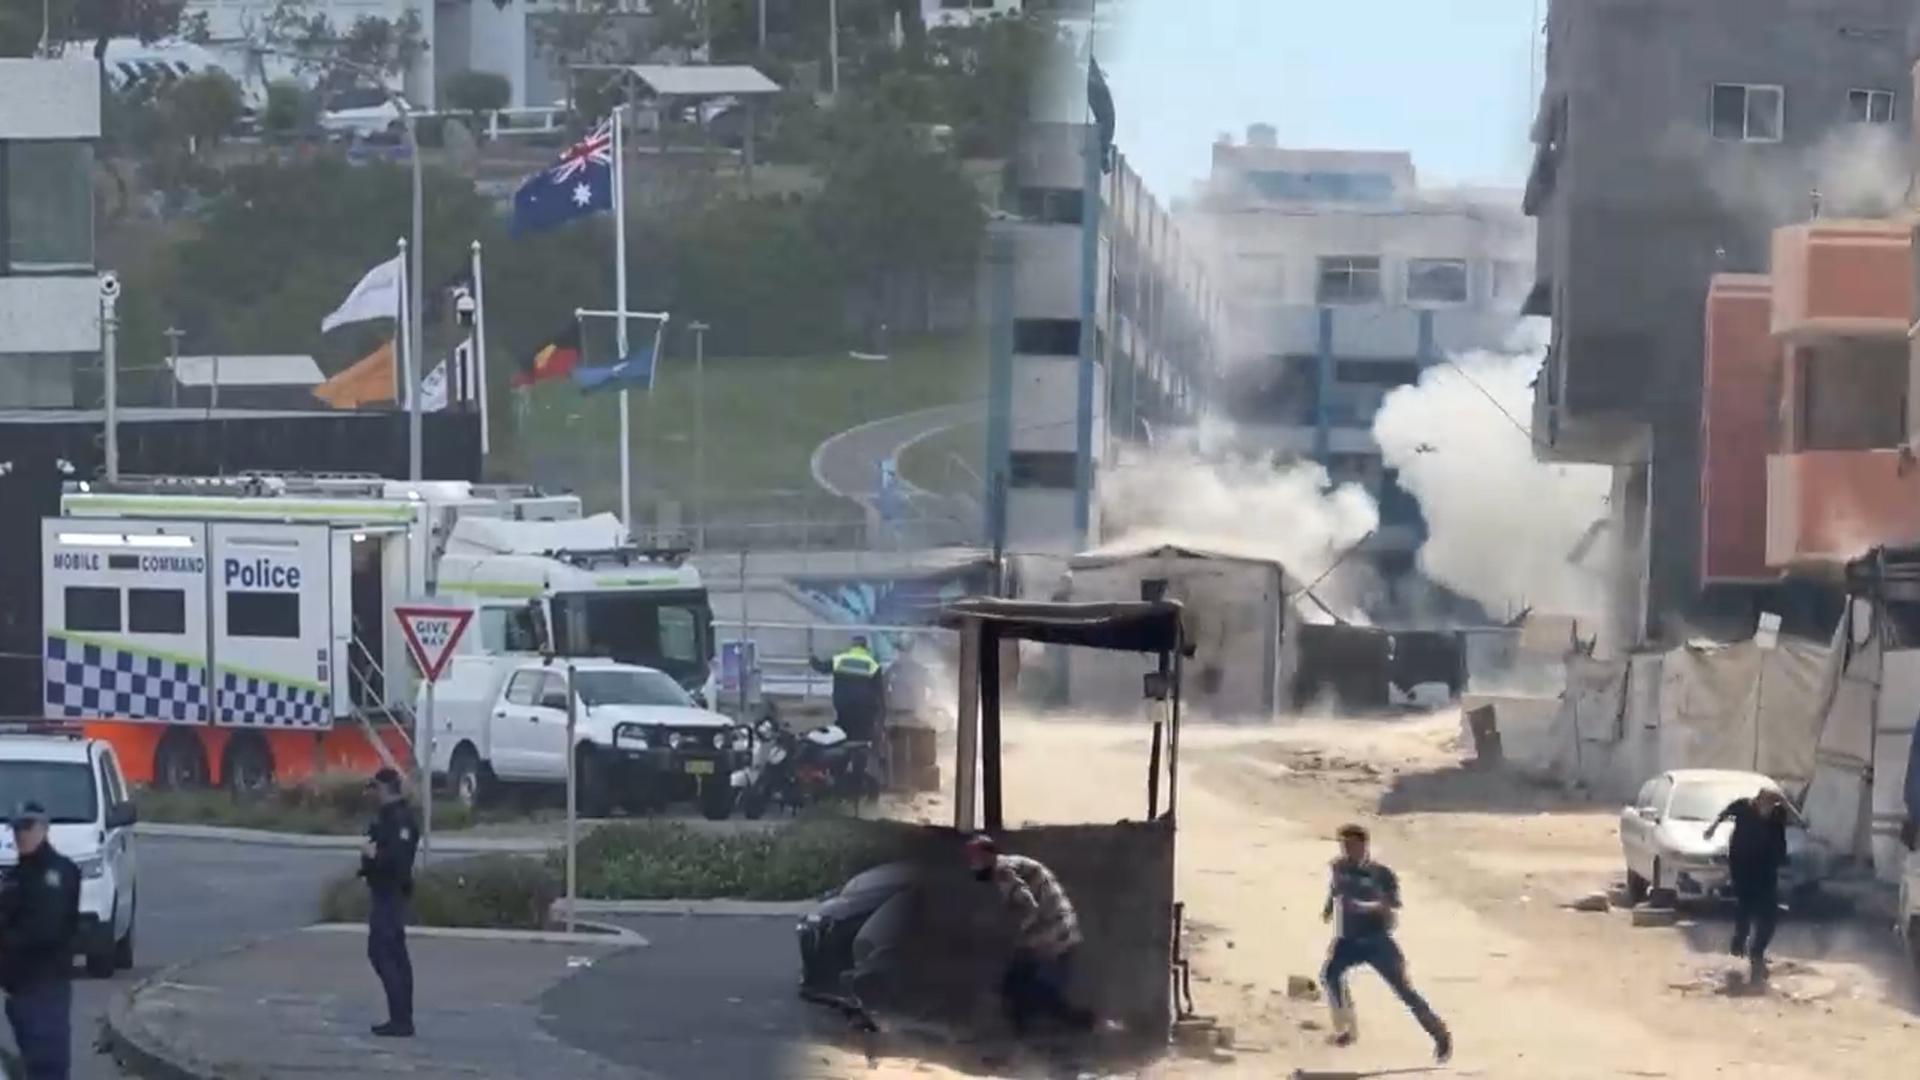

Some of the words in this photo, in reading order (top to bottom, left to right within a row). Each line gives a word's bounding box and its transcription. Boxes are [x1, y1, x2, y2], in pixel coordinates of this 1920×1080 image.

[53, 553, 99, 570] MOBILE
[142, 555, 204, 573] COMMAND
[225, 558, 300, 588] Police
[416, 621, 449, 634] GIVE
